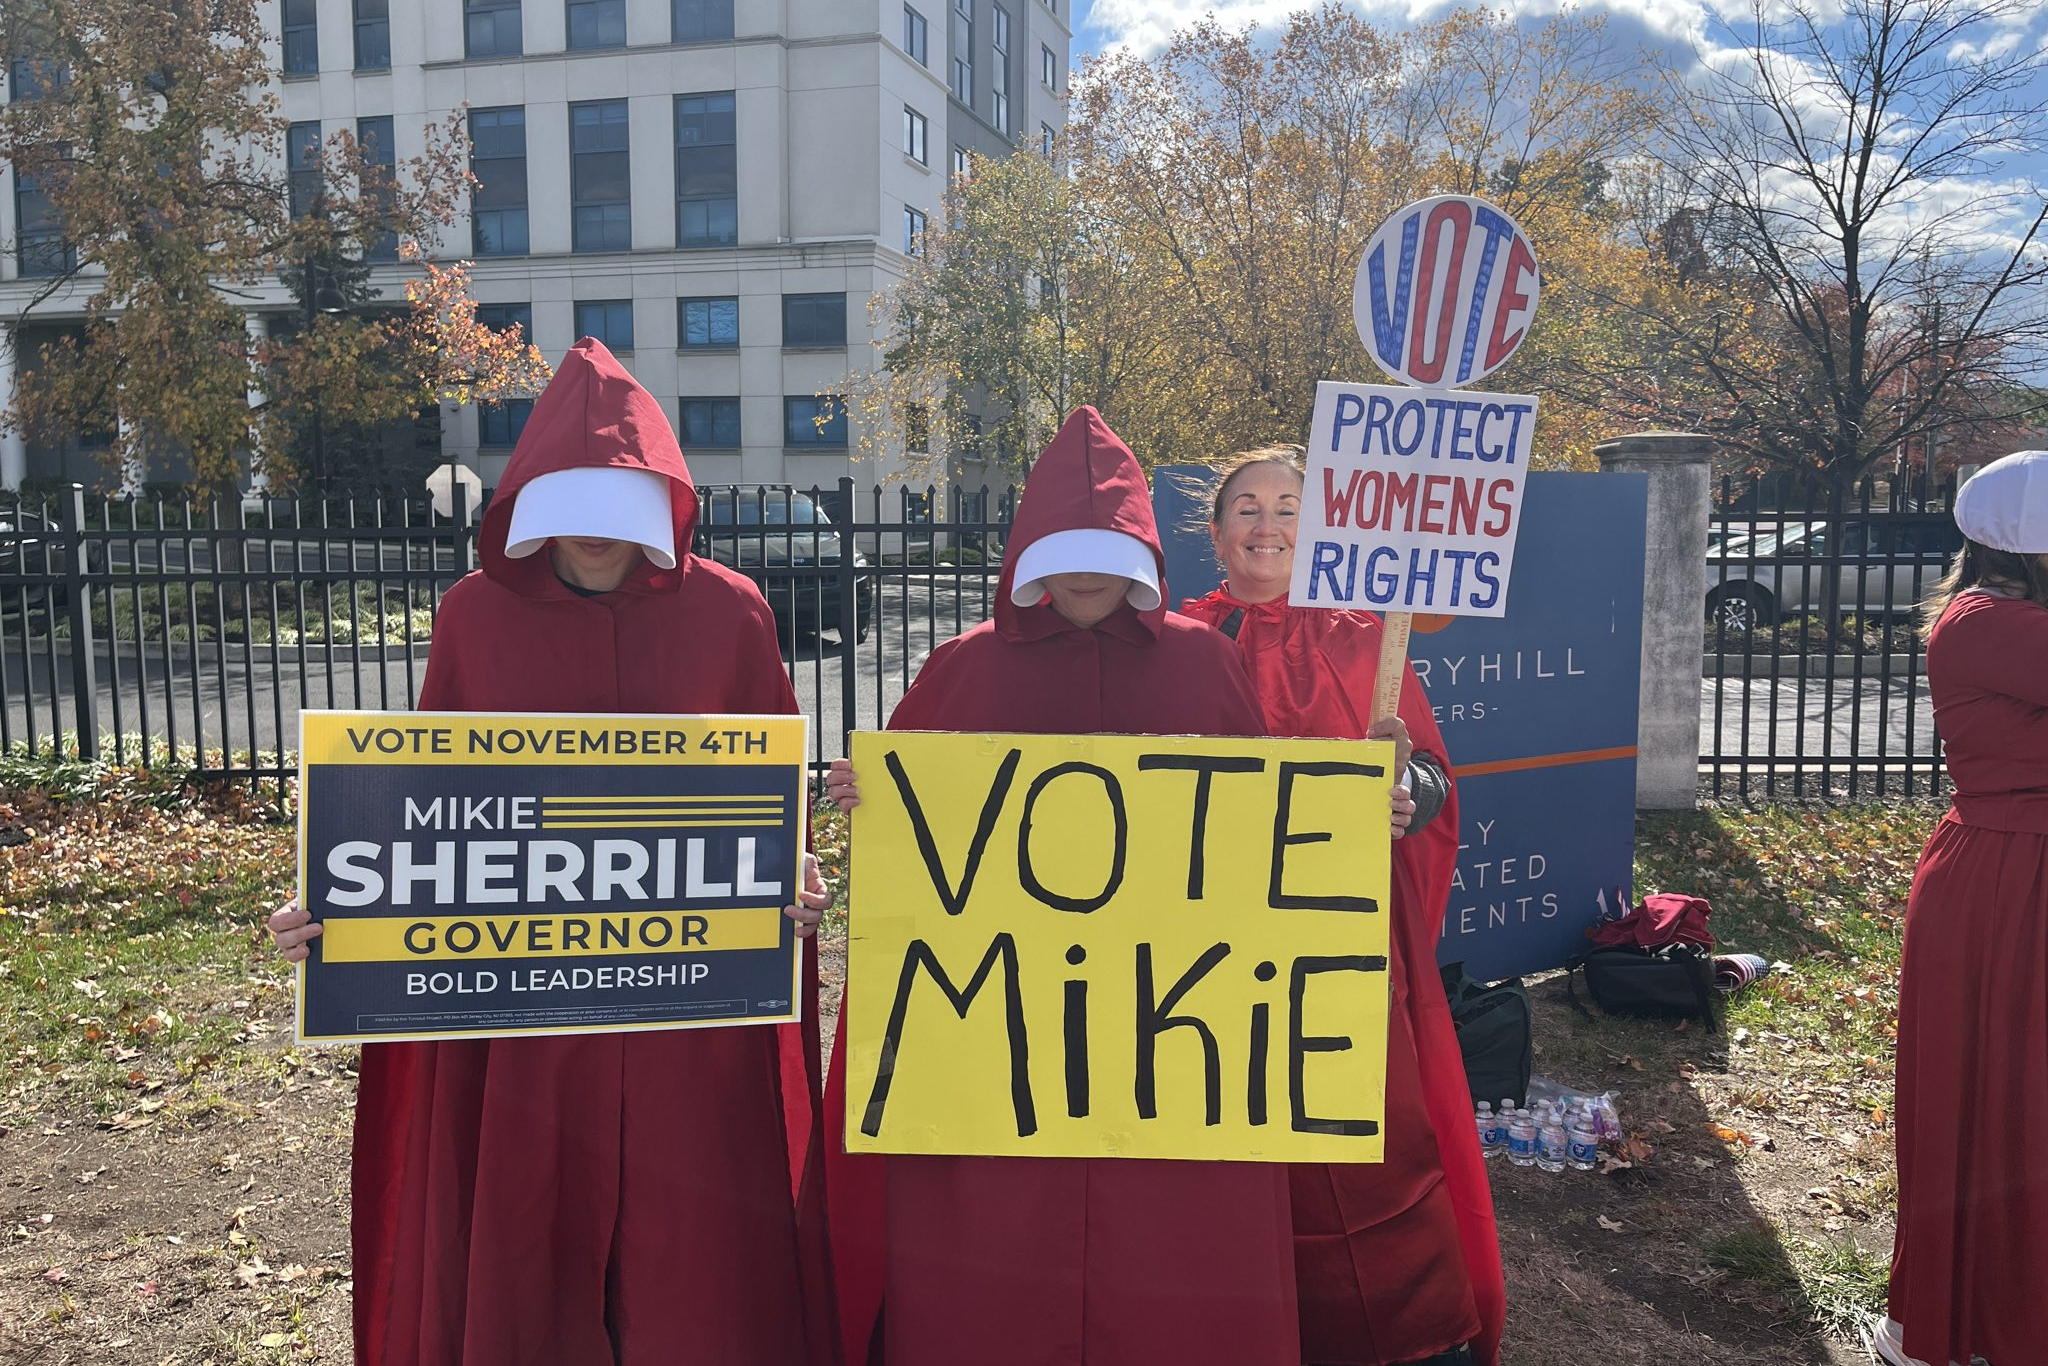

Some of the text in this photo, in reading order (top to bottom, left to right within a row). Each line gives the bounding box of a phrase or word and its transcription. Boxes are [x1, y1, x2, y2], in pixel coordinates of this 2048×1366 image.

[1368, 200, 1536, 384] VOTE
[1332, 393, 1532, 463] PROTECT
[1323, 468, 1513, 537] WOMENS
[1308, 542, 1499, 608] RIGHTS
[1398, 620, 1409, 648] HOME
[1410, 648, 1584, 687] RYHILL
[1387, 677, 1400, 713] DEPOT
[1432, 703, 1498, 723] ERS-
[347, 729, 766, 754] VOTE NOVEMBER 4TH
[405, 797, 536, 830] MIKIE
[884, 749, 1384, 915] VOTE
[326, 837, 781, 906] SHERRILL
[1451, 855, 1545, 891] ATED
[1442, 894, 1558, 937] ENTS
[404, 916, 709, 957] GOVERNOR
[407, 964, 708, 994] BOLD LEADERSHIP
